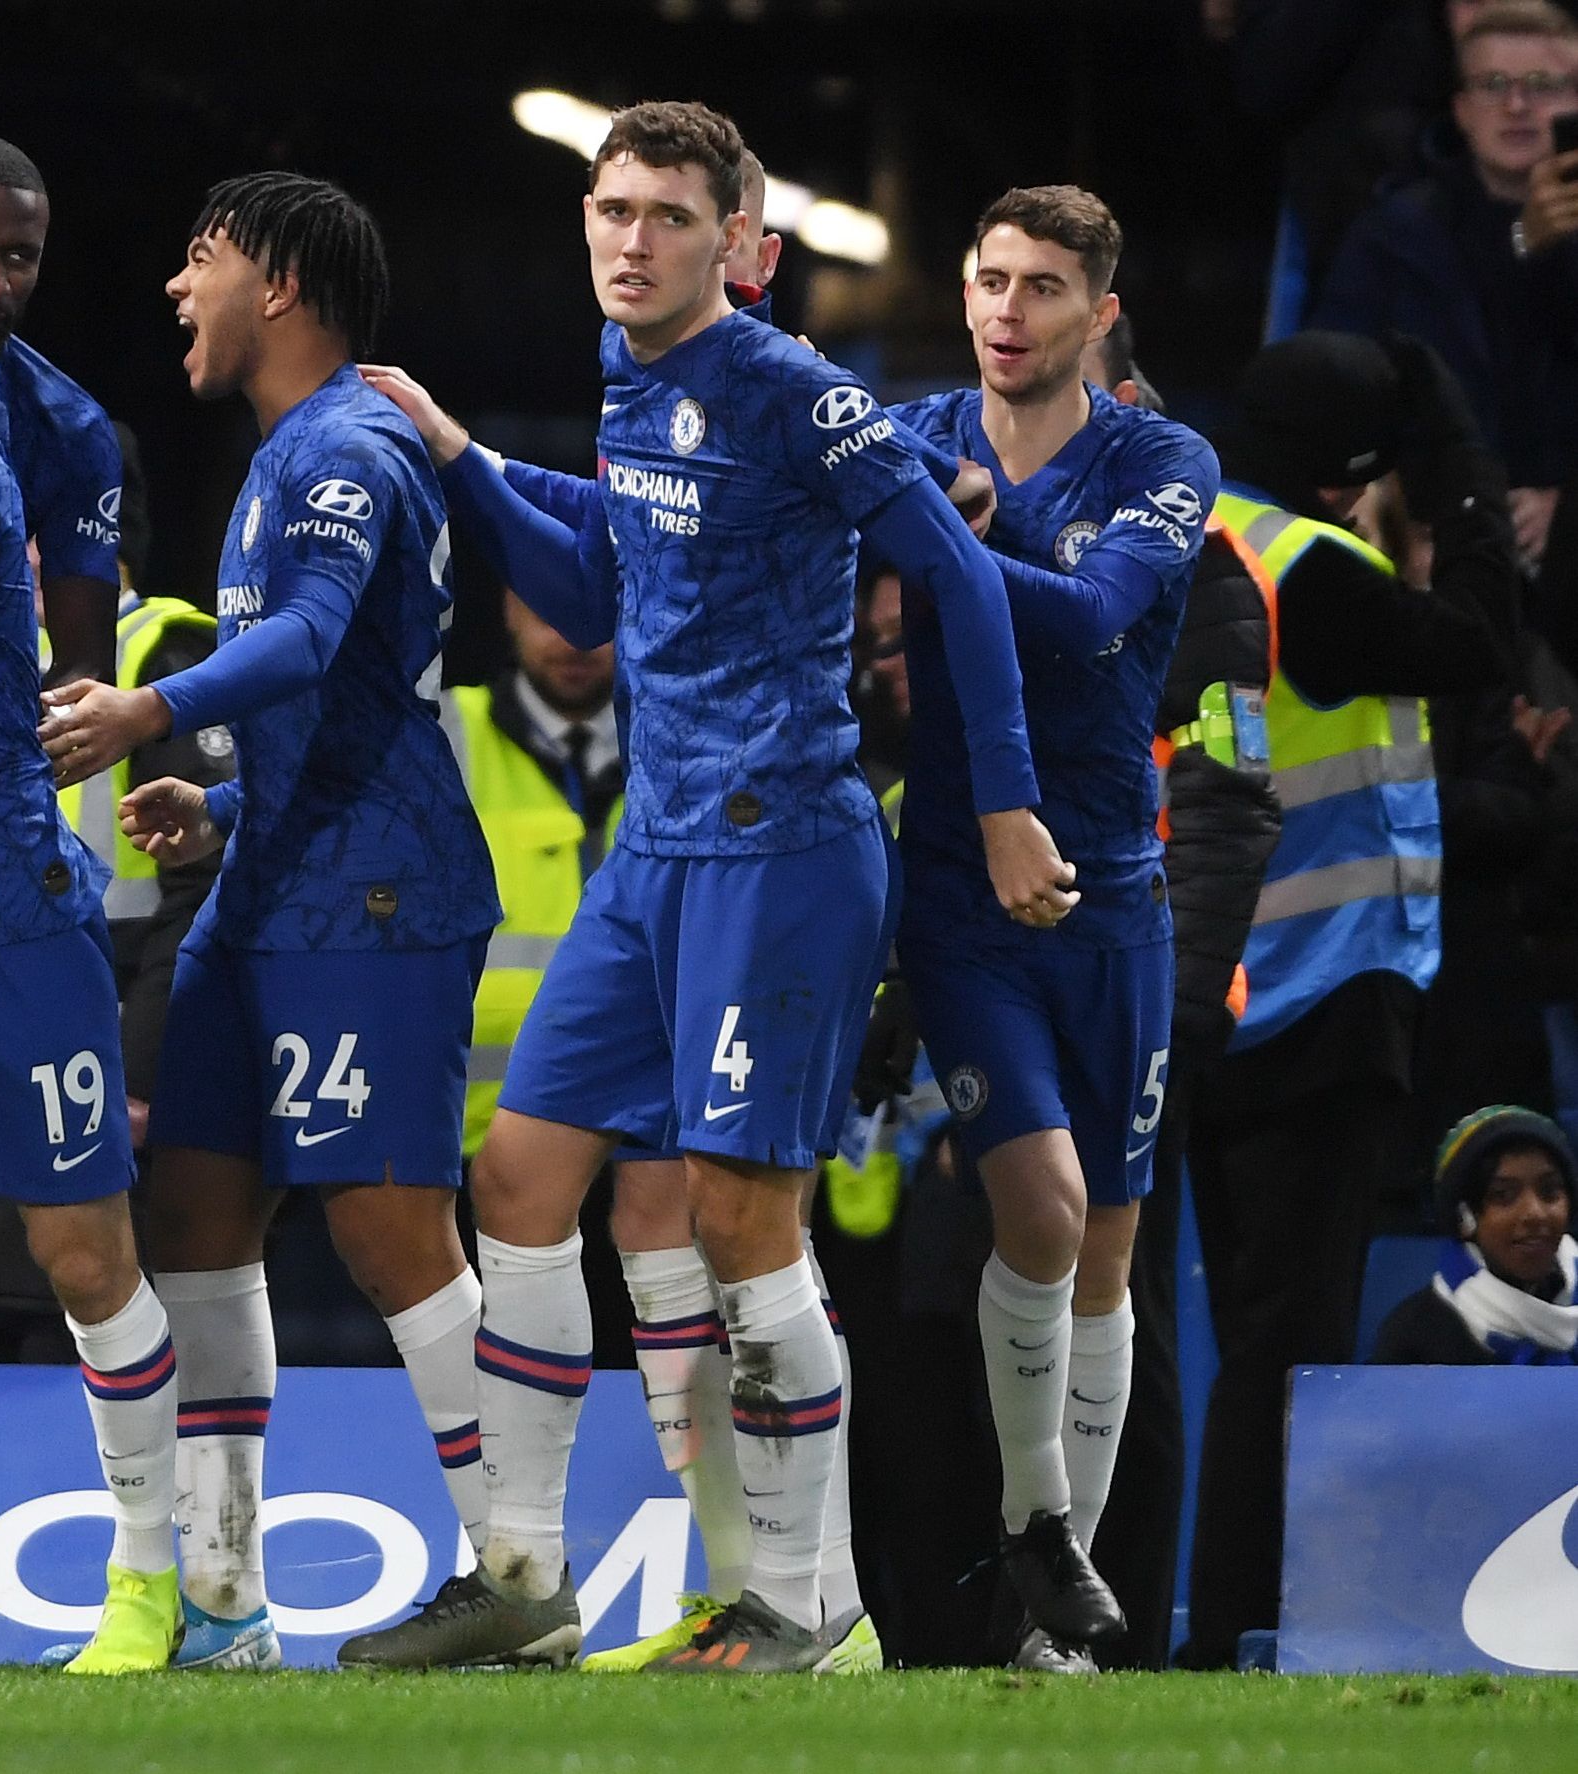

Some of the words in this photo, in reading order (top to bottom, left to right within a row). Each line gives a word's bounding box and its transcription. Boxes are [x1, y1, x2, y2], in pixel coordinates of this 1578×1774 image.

[820, 418, 896, 471] HYUNDA
[608, 463, 701, 512] YOKOHAMA
[286, 519, 372, 563] HYUNDAI
[652, 507, 701, 537] TYRES
[1111, 507, 1189, 551] HYUNDA
[711, 1006, 754, 1092] 4
[31, 1050, 104, 1144] 19
[270, 1032, 371, 1118] 24
[1132, 1048, 1168, 1134] 5
[1074, 1420, 1112, 1437] CFC
